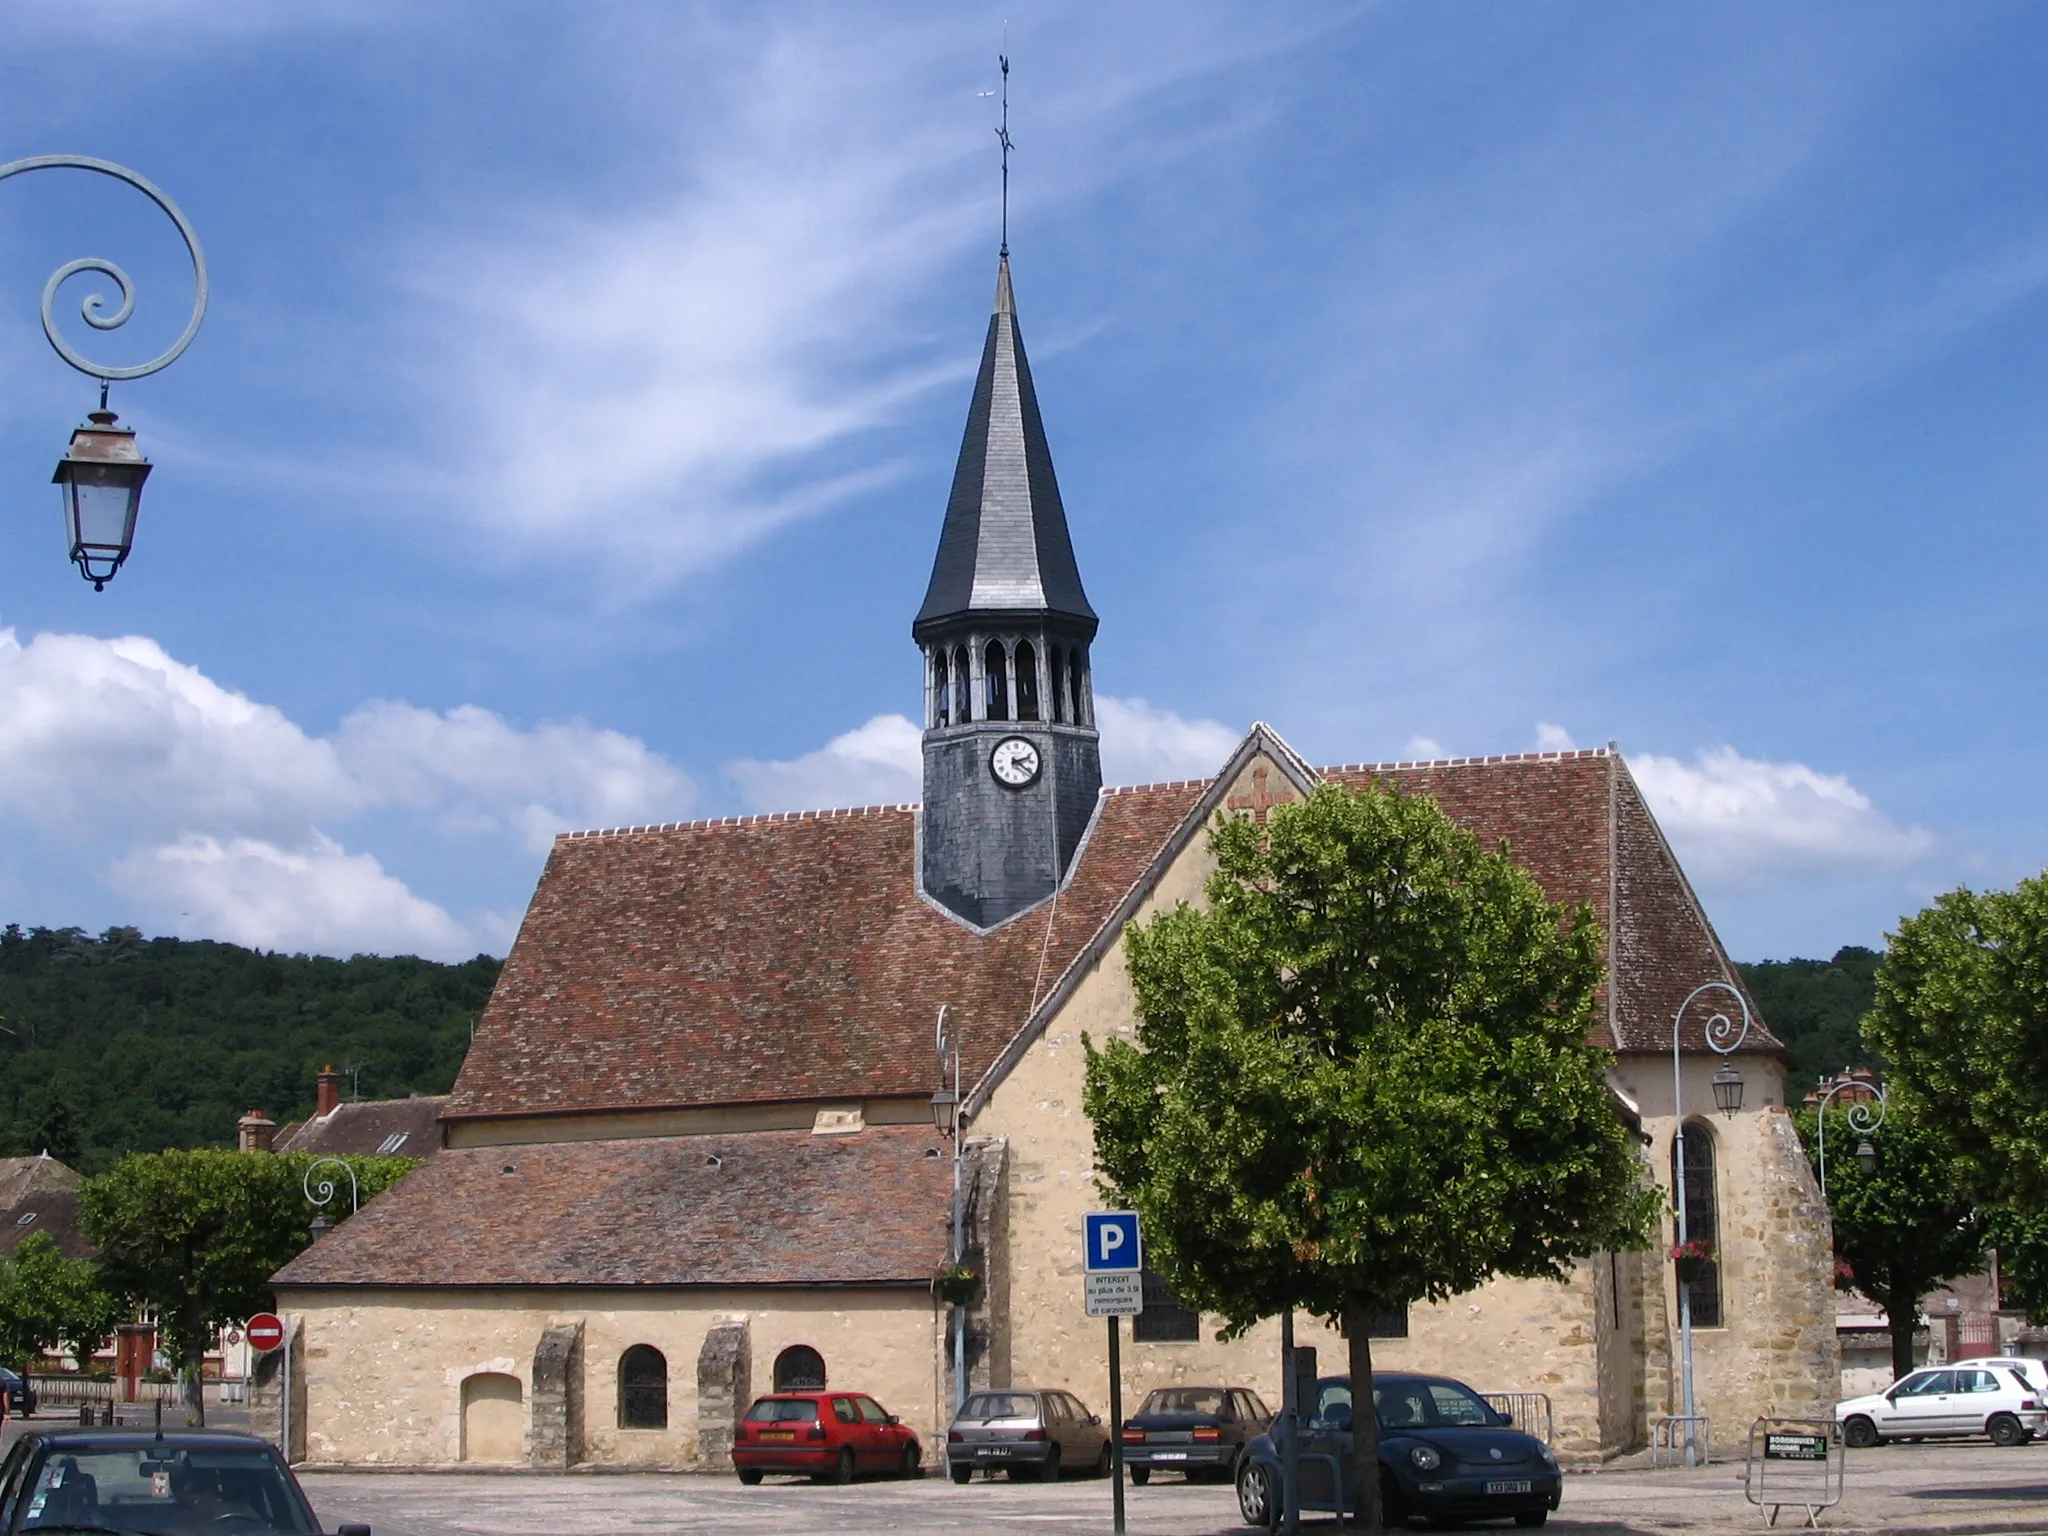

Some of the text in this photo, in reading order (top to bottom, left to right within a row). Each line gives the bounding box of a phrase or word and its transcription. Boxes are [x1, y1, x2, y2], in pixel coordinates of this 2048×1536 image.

[1100, 1224, 1124, 1260] P
[1095, 1276, 1129, 1284] INTERDIT
[1099, 1287, 1113, 1295] plus
[1094, 1297, 1133, 1305] remorques
